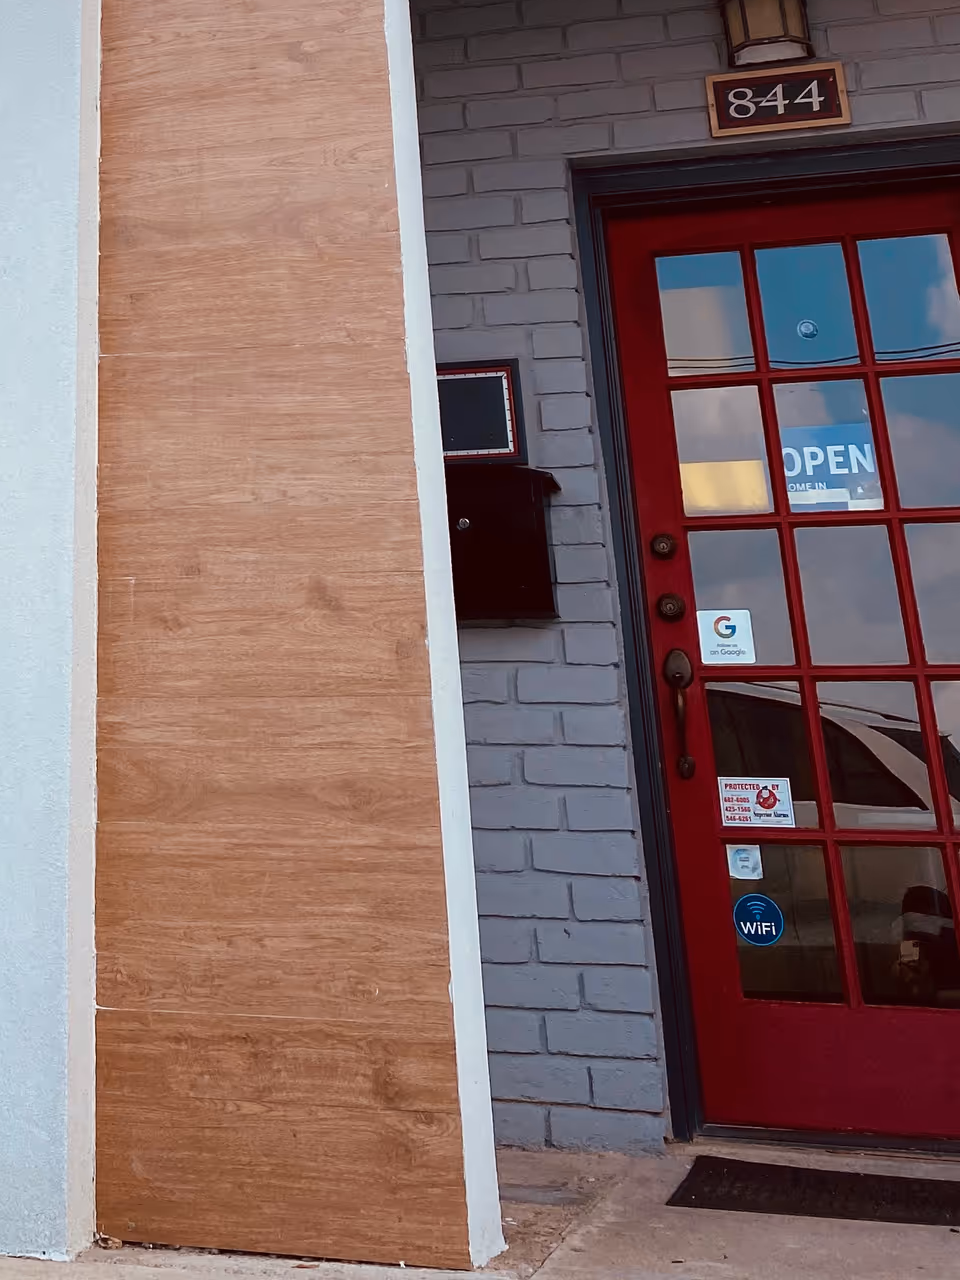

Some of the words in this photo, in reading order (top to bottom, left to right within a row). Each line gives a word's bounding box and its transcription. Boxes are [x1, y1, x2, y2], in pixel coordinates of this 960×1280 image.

[728, 80, 825, 118] 844
[782, 443, 875, 477] OPEN
[720, 648, 746, 656] Google
[724, 783, 760, 791] PROTECTED
[740, 921, 776, 936] WiFi
